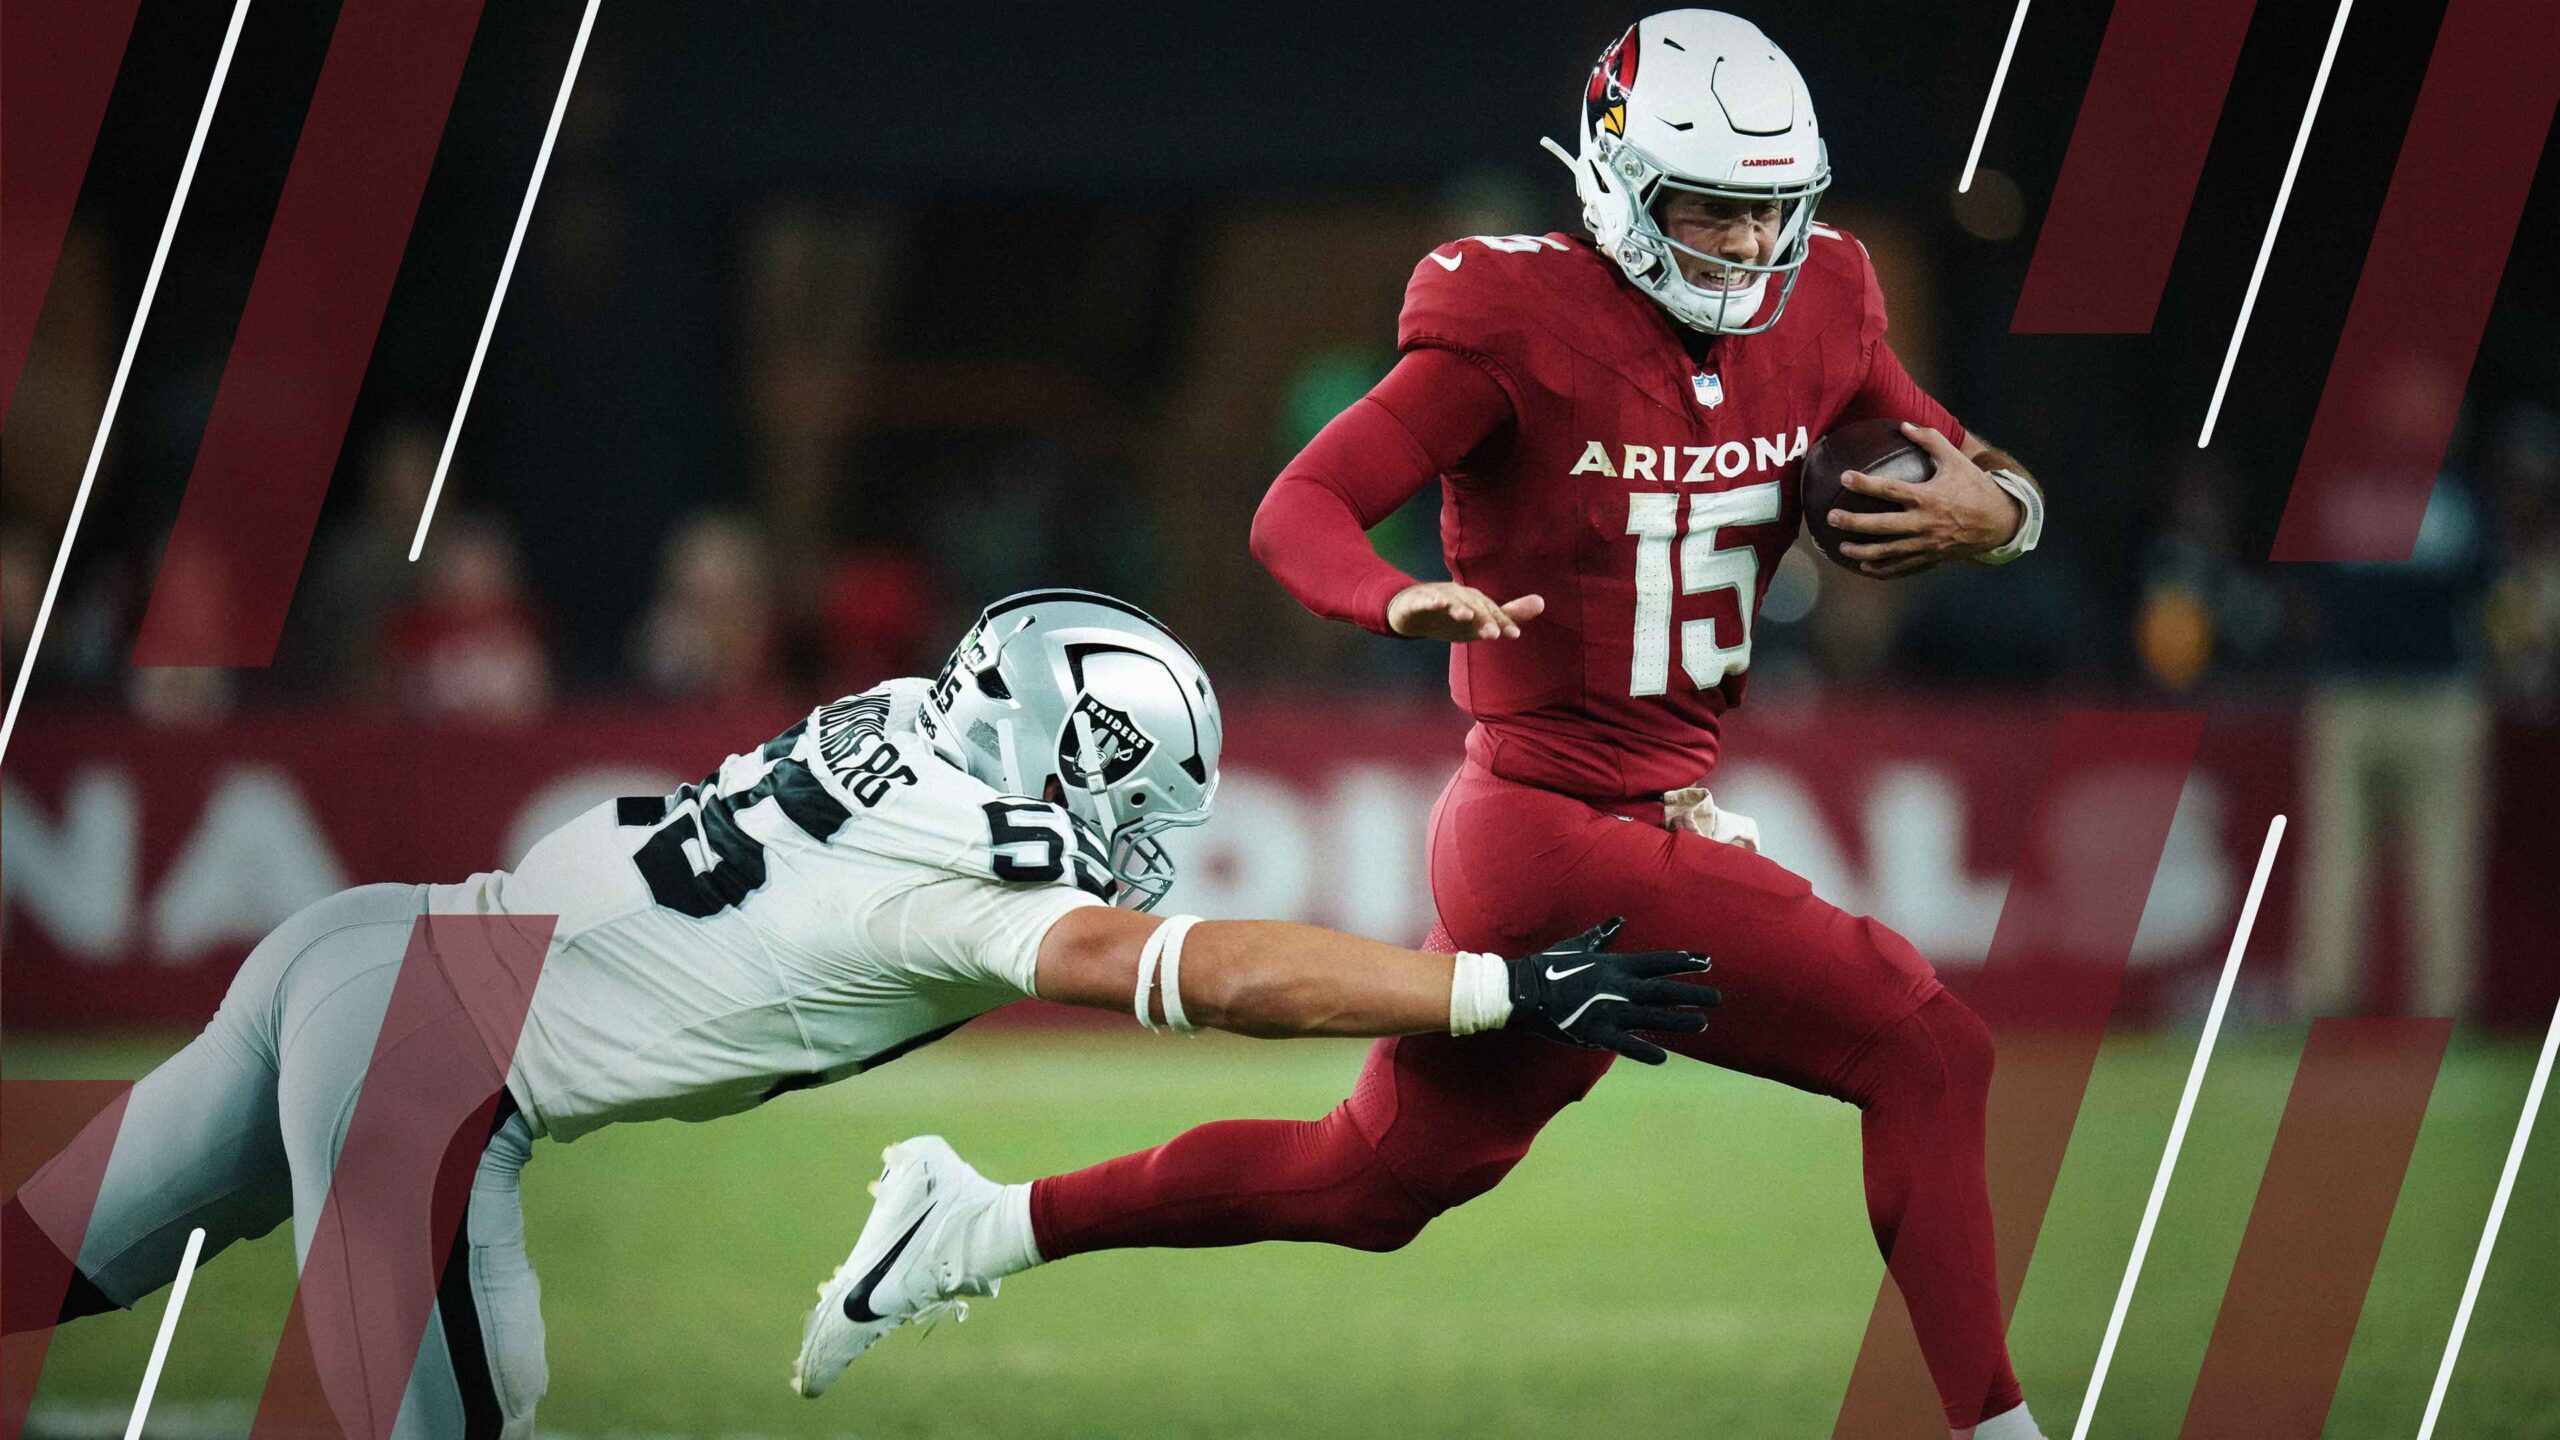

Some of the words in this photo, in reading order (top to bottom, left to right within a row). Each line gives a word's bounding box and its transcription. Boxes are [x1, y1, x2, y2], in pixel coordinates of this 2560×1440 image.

[1742, 157, 1795, 167] CARDINALS
[1569, 426, 1809, 483] ARIZONA
[1626, 480, 1781, 697] 15
[1086, 700, 1147, 749] RAIDERS
